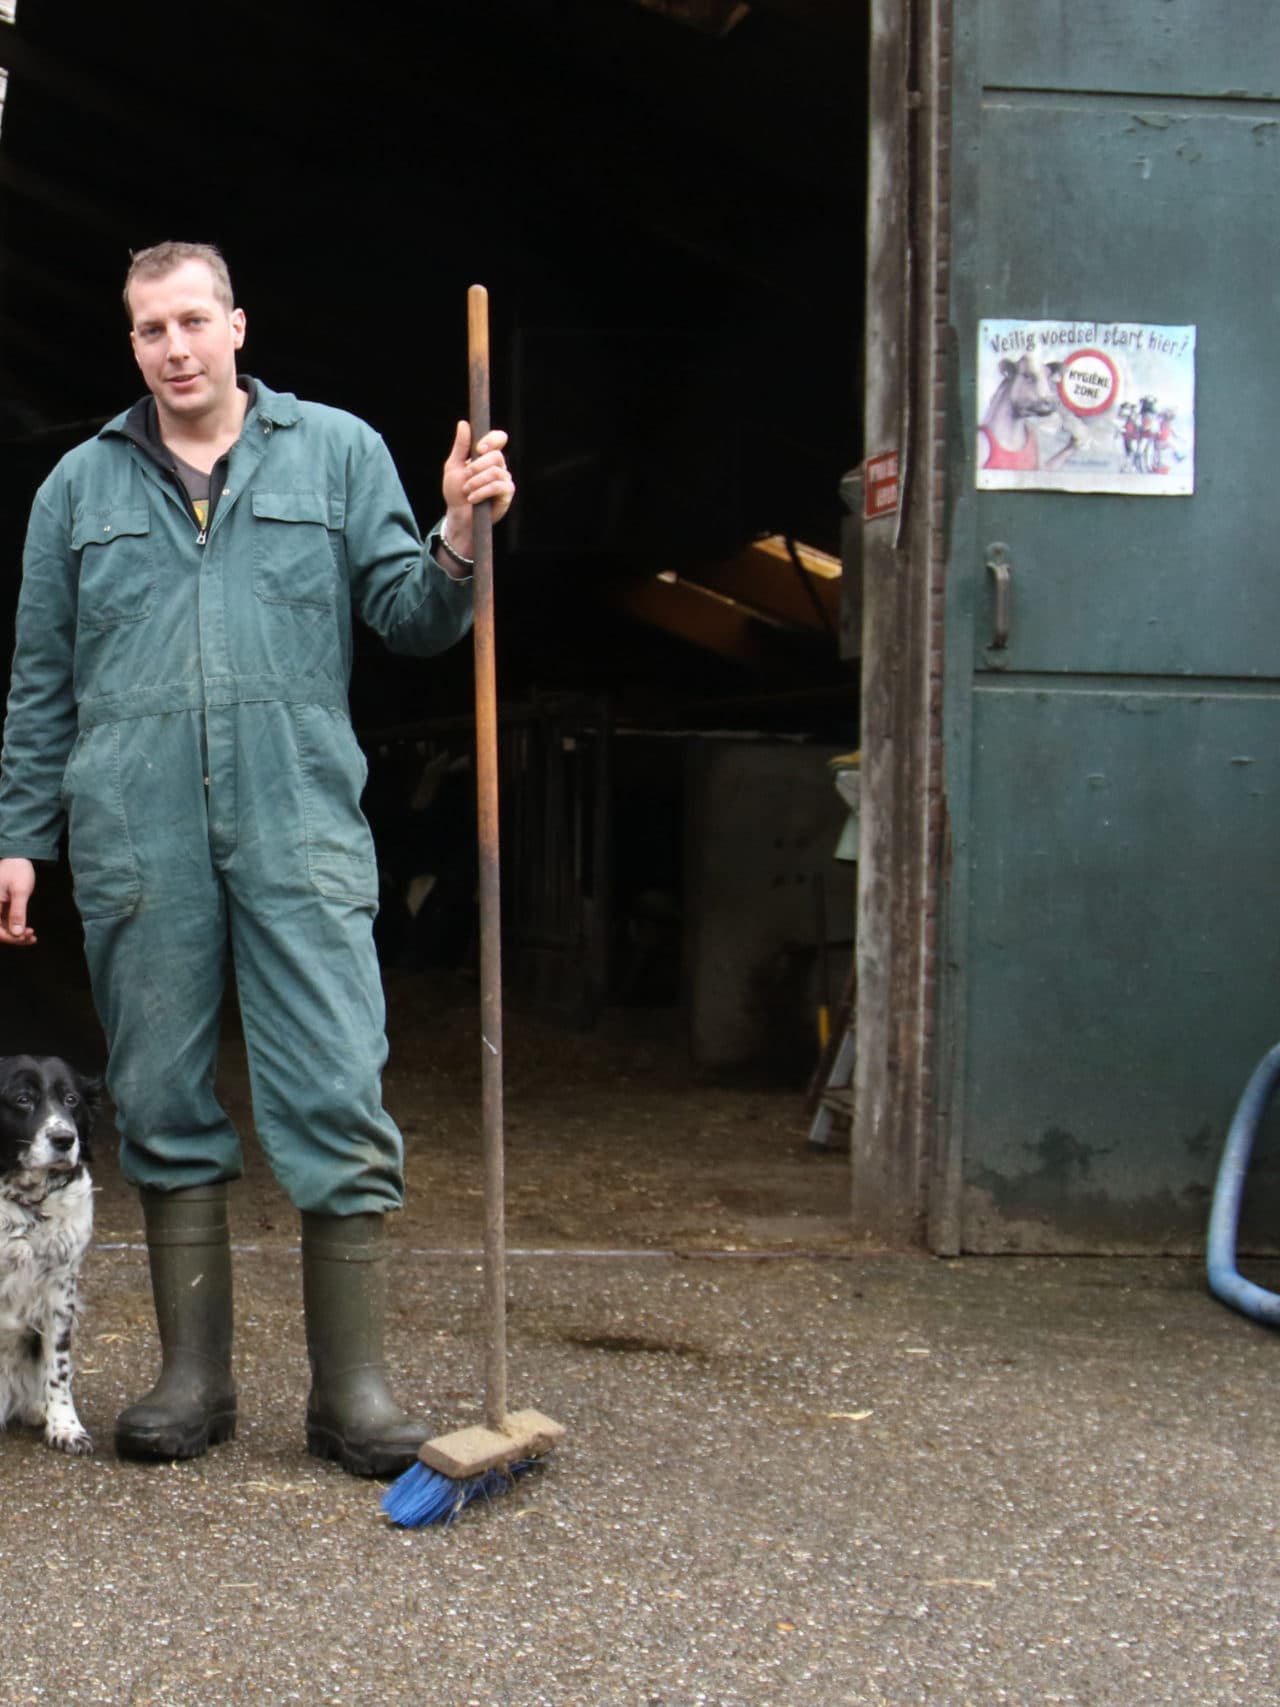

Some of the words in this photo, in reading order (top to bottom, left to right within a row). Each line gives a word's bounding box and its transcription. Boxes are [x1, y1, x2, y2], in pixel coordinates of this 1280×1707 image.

[991, 331, 1035, 353] Veilig
[1040, 325, 1098, 345] voedsel
[1103, 327, 1143, 349] start
[1148, 333, 1189, 357] hier!
[1073, 384, 1100, 399] ZONE
